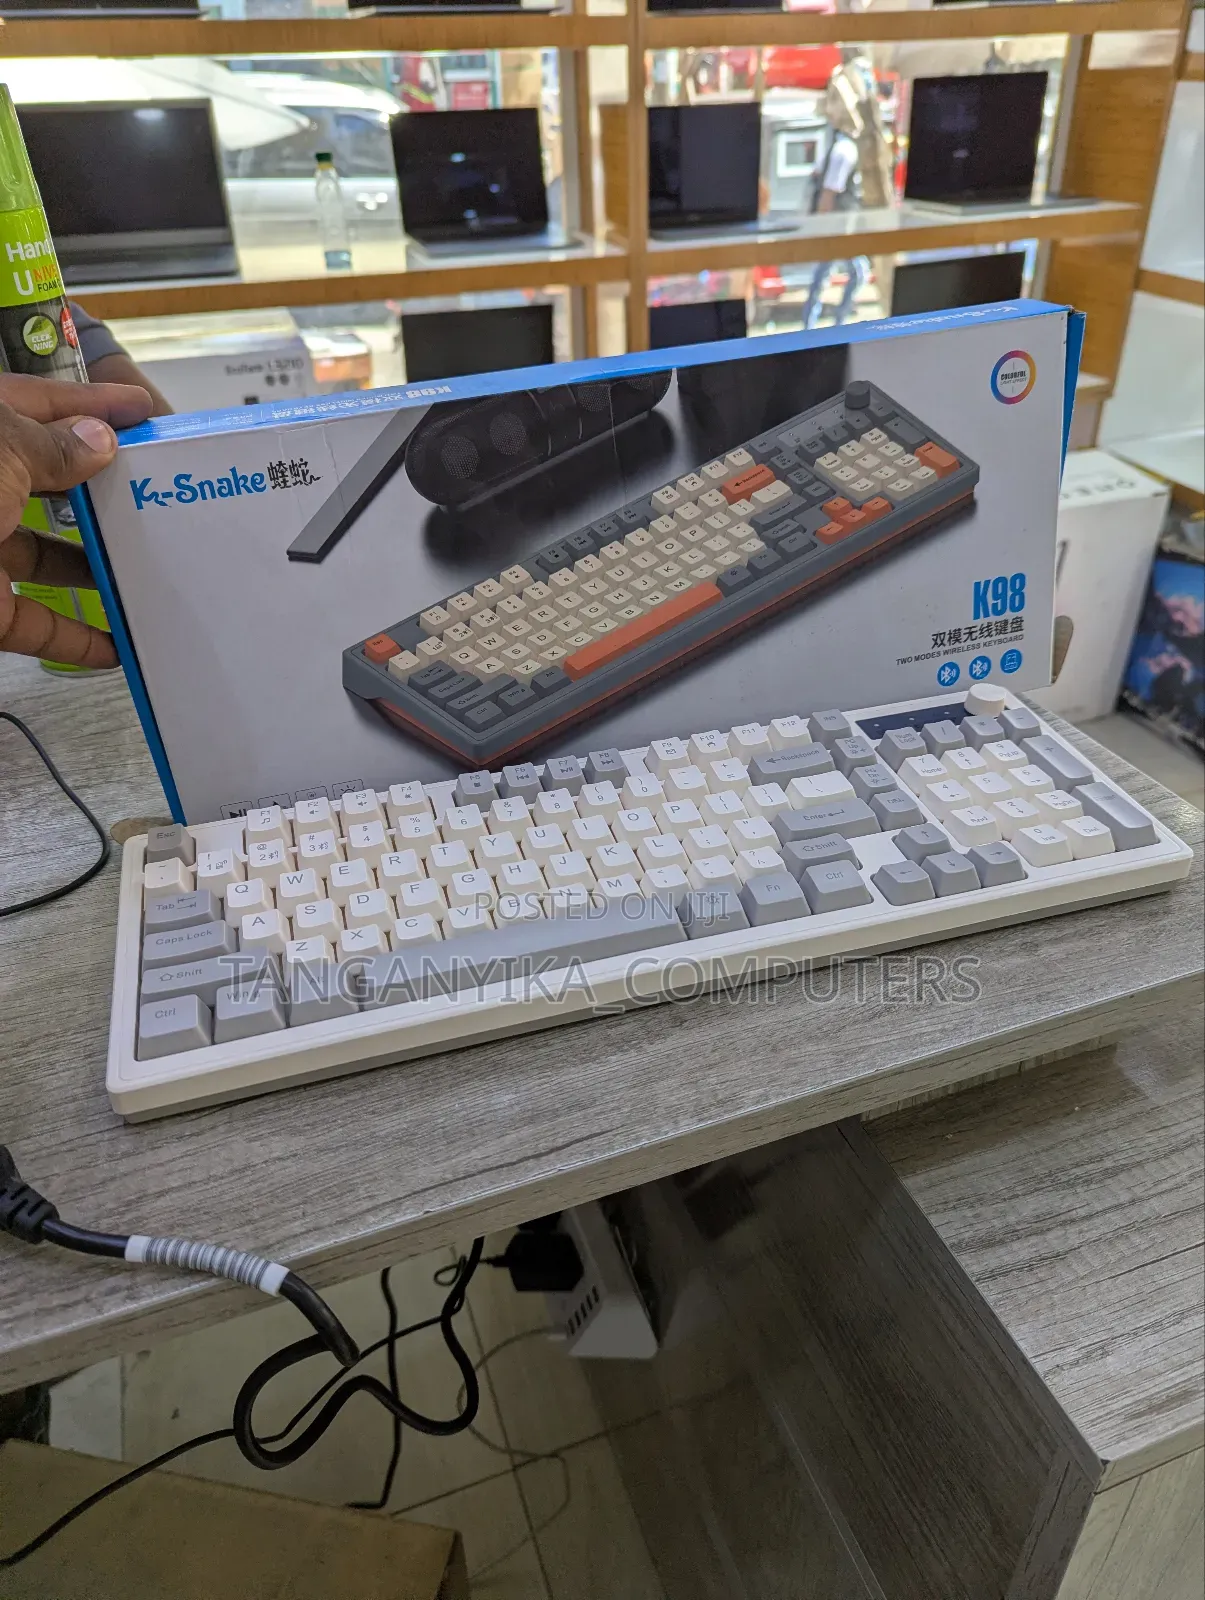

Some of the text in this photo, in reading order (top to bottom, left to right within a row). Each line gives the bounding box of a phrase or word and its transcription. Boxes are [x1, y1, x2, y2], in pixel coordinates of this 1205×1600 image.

[1001, 370, 1026, 381] COLORFUL
[405, 385, 452, 399] K98
[130, 466, 267, 510] K-Snake
[973, 573, 1026, 620] K98
[512, 624, 523, 632] E
[931, 616, 1024, 649] 双模无线键盘
[484, 637, 497, 646] W
[896, 634, 1024, 666] TWO MODES WIRELESS KEYBOARD
[670, 805, 681, 814] P
[627, 812, 639, 822] O
[156, 831, 176, 839] Esc
[534, 829, 546, 838] U
[486, 837, 497, 847] Y
[651, 839, 664, 848] L
[438, 846, 449, 856] T
[604, 846, 618, 856] K
[389, 855, 401, 865] R
[559, 856, 567, 865] J
[338, 865, 350, 876] E
[508, 864, 522, 874] H
[286, 874, 304, 885] W
[461, 874, 475, 883] G
[826, 871, 844, 880] Ctrl
[606, 878, 623, 889] M
[766, 884, 781, 893] Fn
[235, 884, 249, 894] Q
[409, 884, 420, 894] F
[559, 888, 573, 898] N
[356, 894, 370, 904] D
[155, 903, 175, 911] Tab
[304, 905, 317, 915] S
[456, 907, 469, 917] V
[252, 916, 266, 927] A
[404, 918, 418, 928] C
[155, 929, 213, 946] Caps Lock
[350, 930, 364, 940] X
[295, 942, 309, 951] Z
[176, 968, 203, 979] Shift
[155, 1008, 176, 1019] Ctrl
